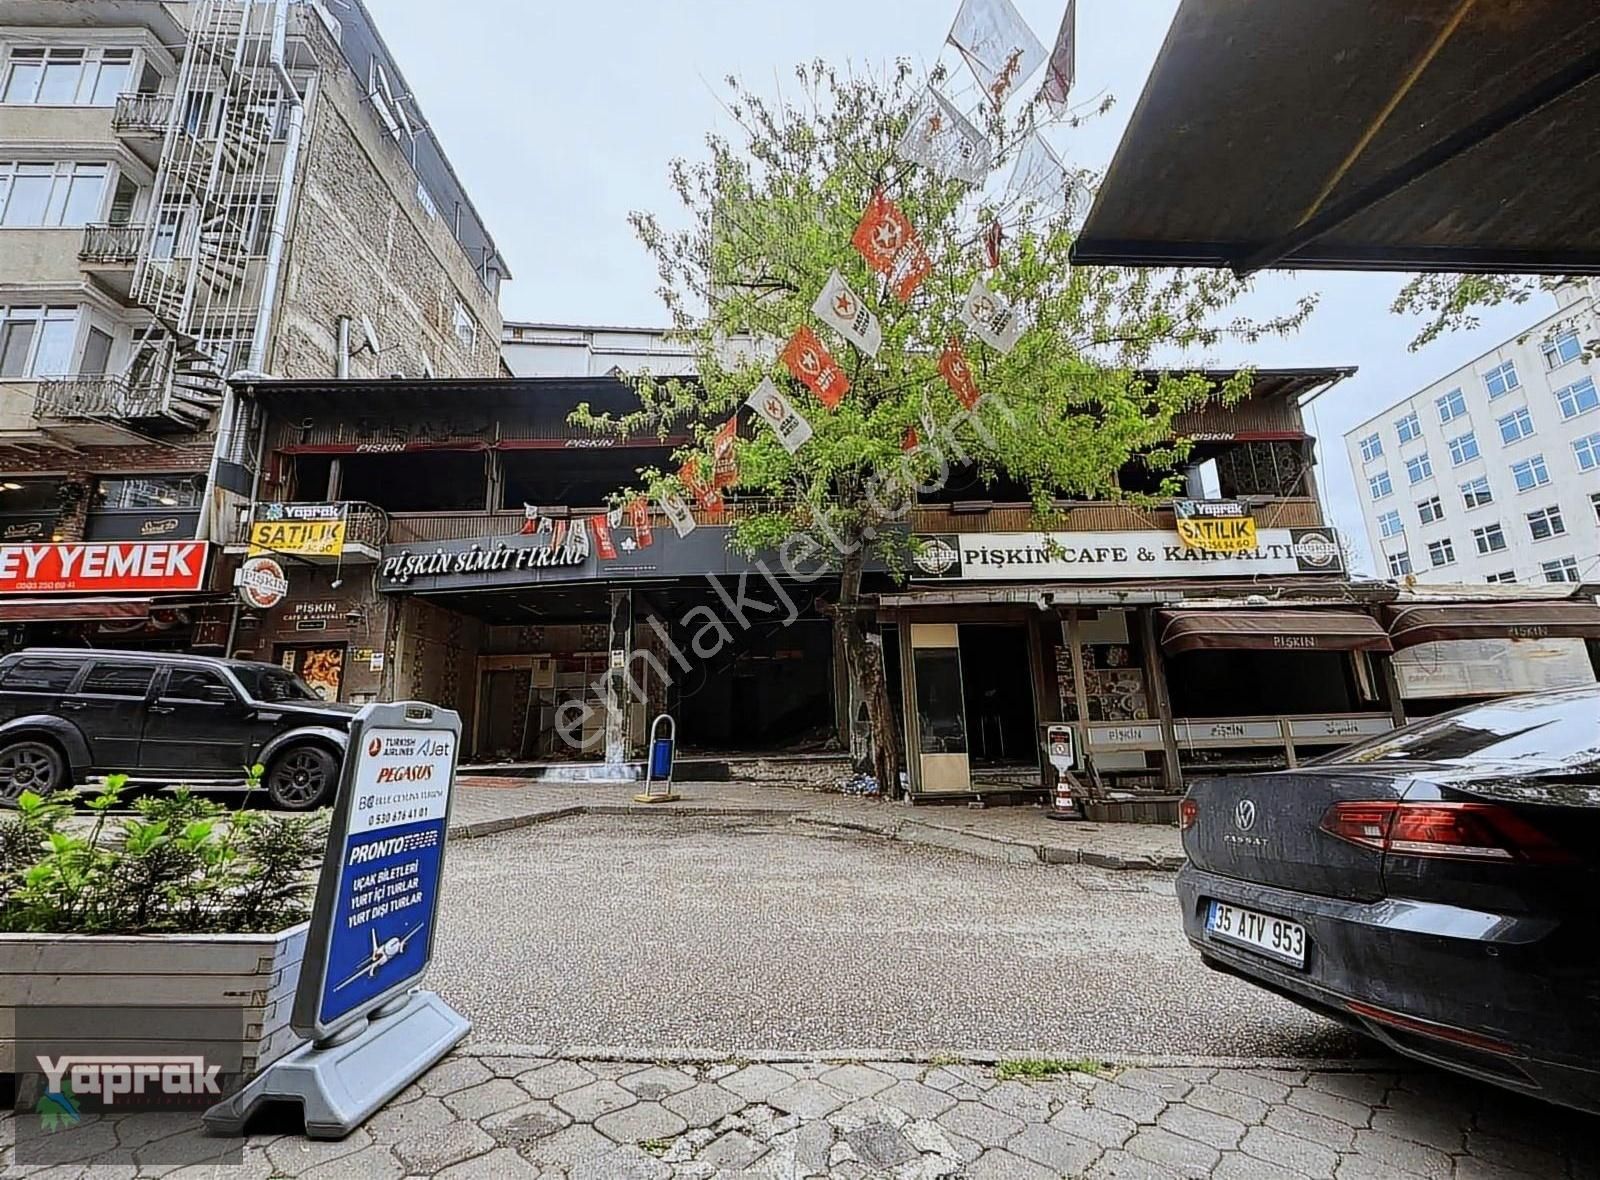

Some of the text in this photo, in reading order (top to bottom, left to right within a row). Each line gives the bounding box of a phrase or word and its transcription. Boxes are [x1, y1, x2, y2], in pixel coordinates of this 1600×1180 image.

[284, 505, 339, 521] Yaprak
[1196, 502, 1243, 517] Yaprak
[258, 524, 342, 545] SATILIK
[1182, 522, 1251, 540] SATILIK
[57, 545, 194, 578] YEMEK
[383, 547, 452, 584] PİŞKİN
[454, 543, 515, 572] SİMİT
[965, 546, 1051, 568] PİŞKİN
[1061, 547, 1128, 563] CAFE
[1137, 547, 1156, 562] &
[383, 747, 414, 757] AIRLINES
[376, 764, 435, 784] PEGASUS
[353, 859, 419, 892] UÇAK BİLETLERİ
[351, 891, 373, 910] YURT
[387, 877, 419, 897] TURLAR
[348, 891, 423, 929] YURT DIŞI TURLAR
[1216, 906, 1304, 955] 35 ATV 953
